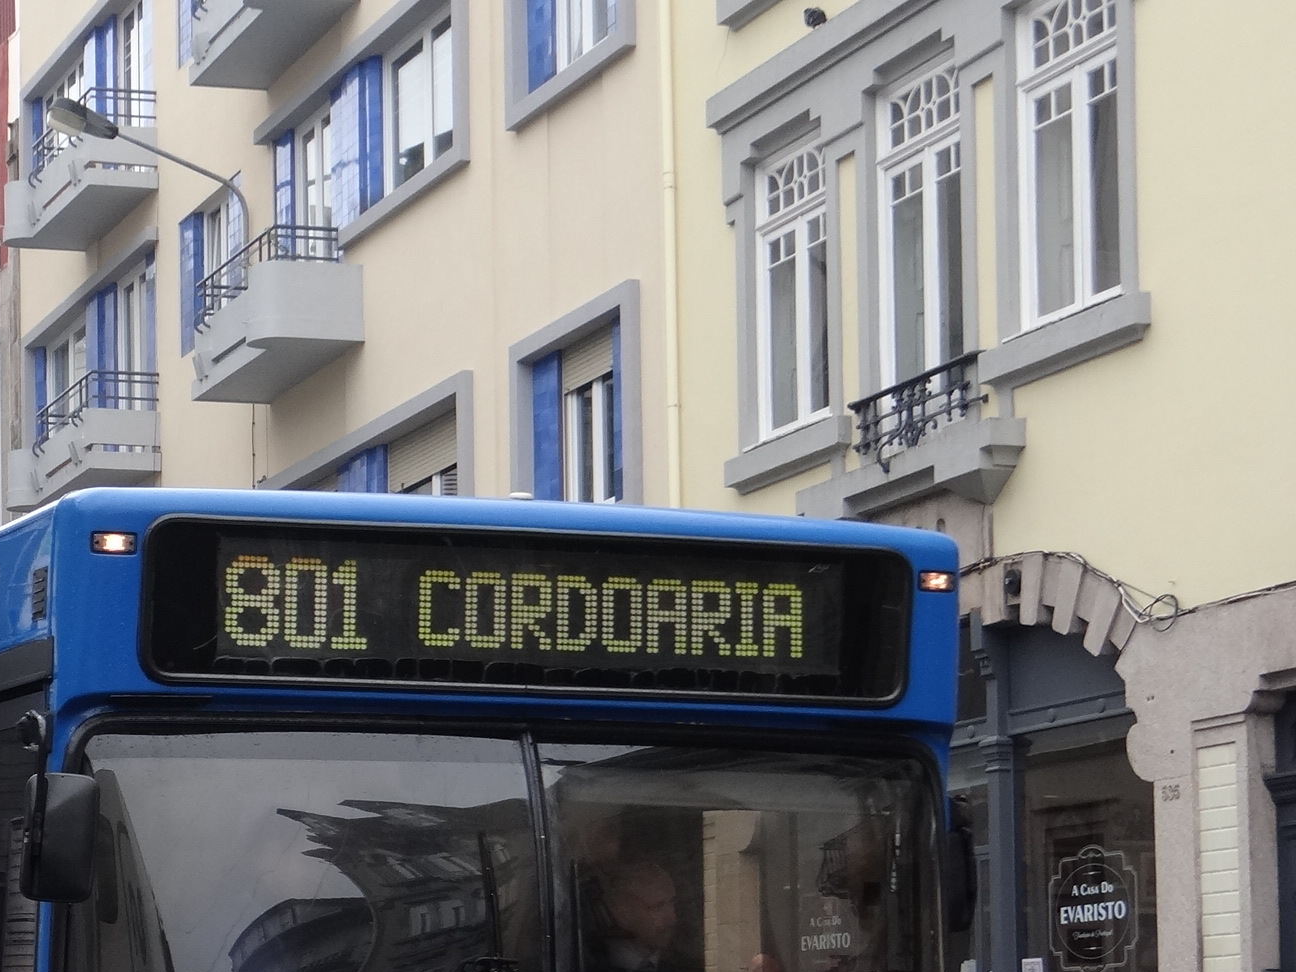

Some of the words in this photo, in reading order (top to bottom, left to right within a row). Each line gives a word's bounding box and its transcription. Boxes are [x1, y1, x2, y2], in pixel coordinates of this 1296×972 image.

[224, 555, 367, 650] 801
[419, 569, 803, 659] CORDOARIA
[1071, 885, 1079, 896] A
[1060, 900, 1126, 925] EVARISTO
[801, 932, 851, 952] EVARISTO
